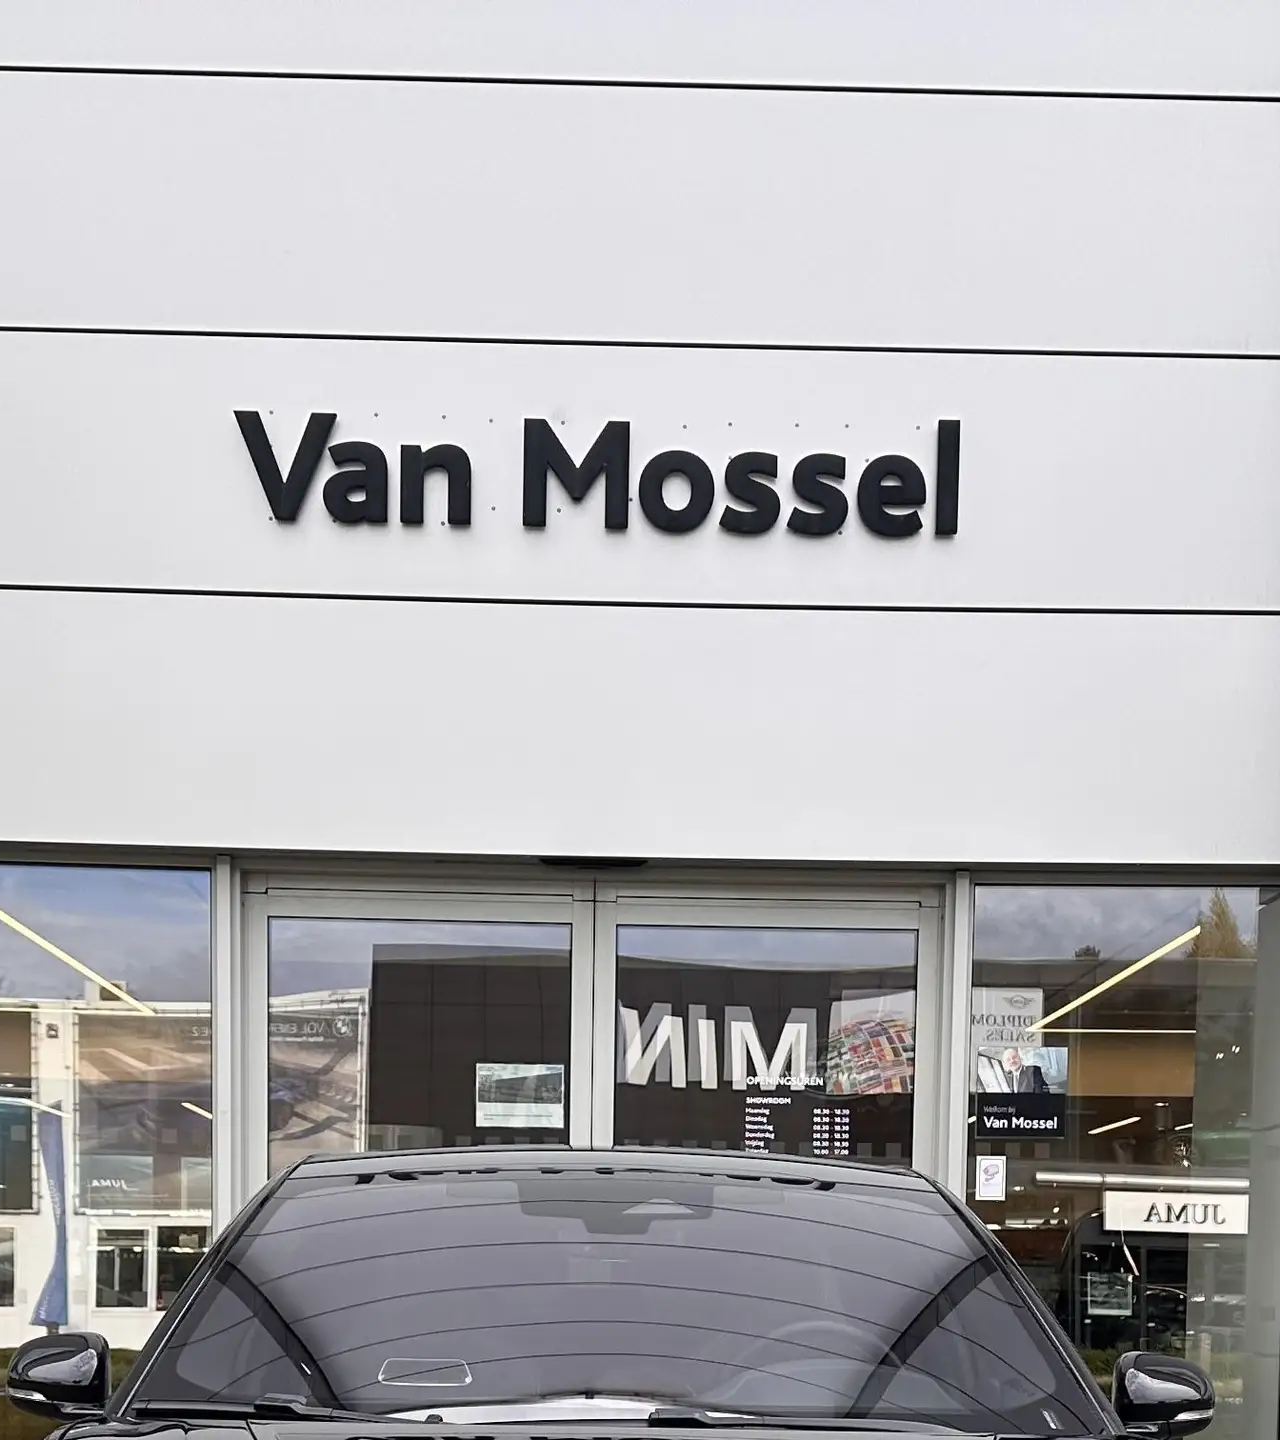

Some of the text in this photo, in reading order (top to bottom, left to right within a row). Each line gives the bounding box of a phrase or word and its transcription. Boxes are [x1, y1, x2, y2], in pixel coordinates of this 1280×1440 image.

[232, 409, 962, 537] Van Mossel
[746, 1075, 824, 1086] OPENINGSUREN
[745, 1096, 792, 1105] SHOWROOM
[983, 1115, 1058, 1130] Van Mossel
